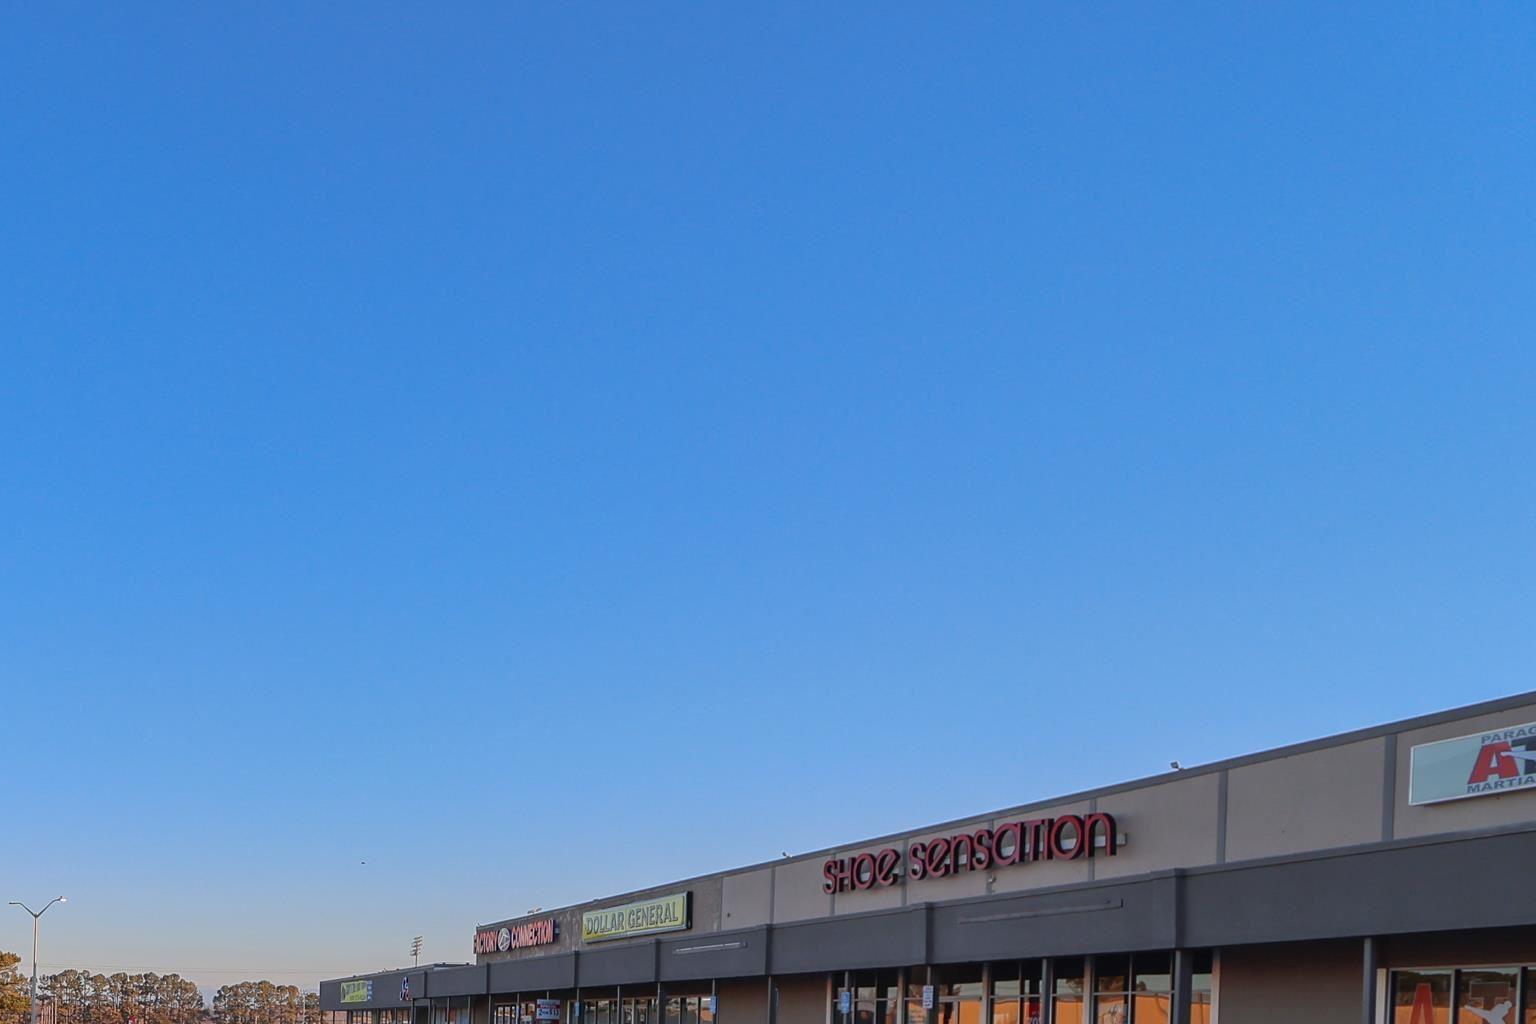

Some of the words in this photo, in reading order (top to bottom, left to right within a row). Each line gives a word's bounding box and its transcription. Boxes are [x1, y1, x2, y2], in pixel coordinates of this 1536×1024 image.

[586, 911, 624, 935] DOLLAR
[628, 901, 678, 928] GENERAL
[472, 930, 498, 954] FACTORY
[511, 918, 554, 949] CONNECTION
